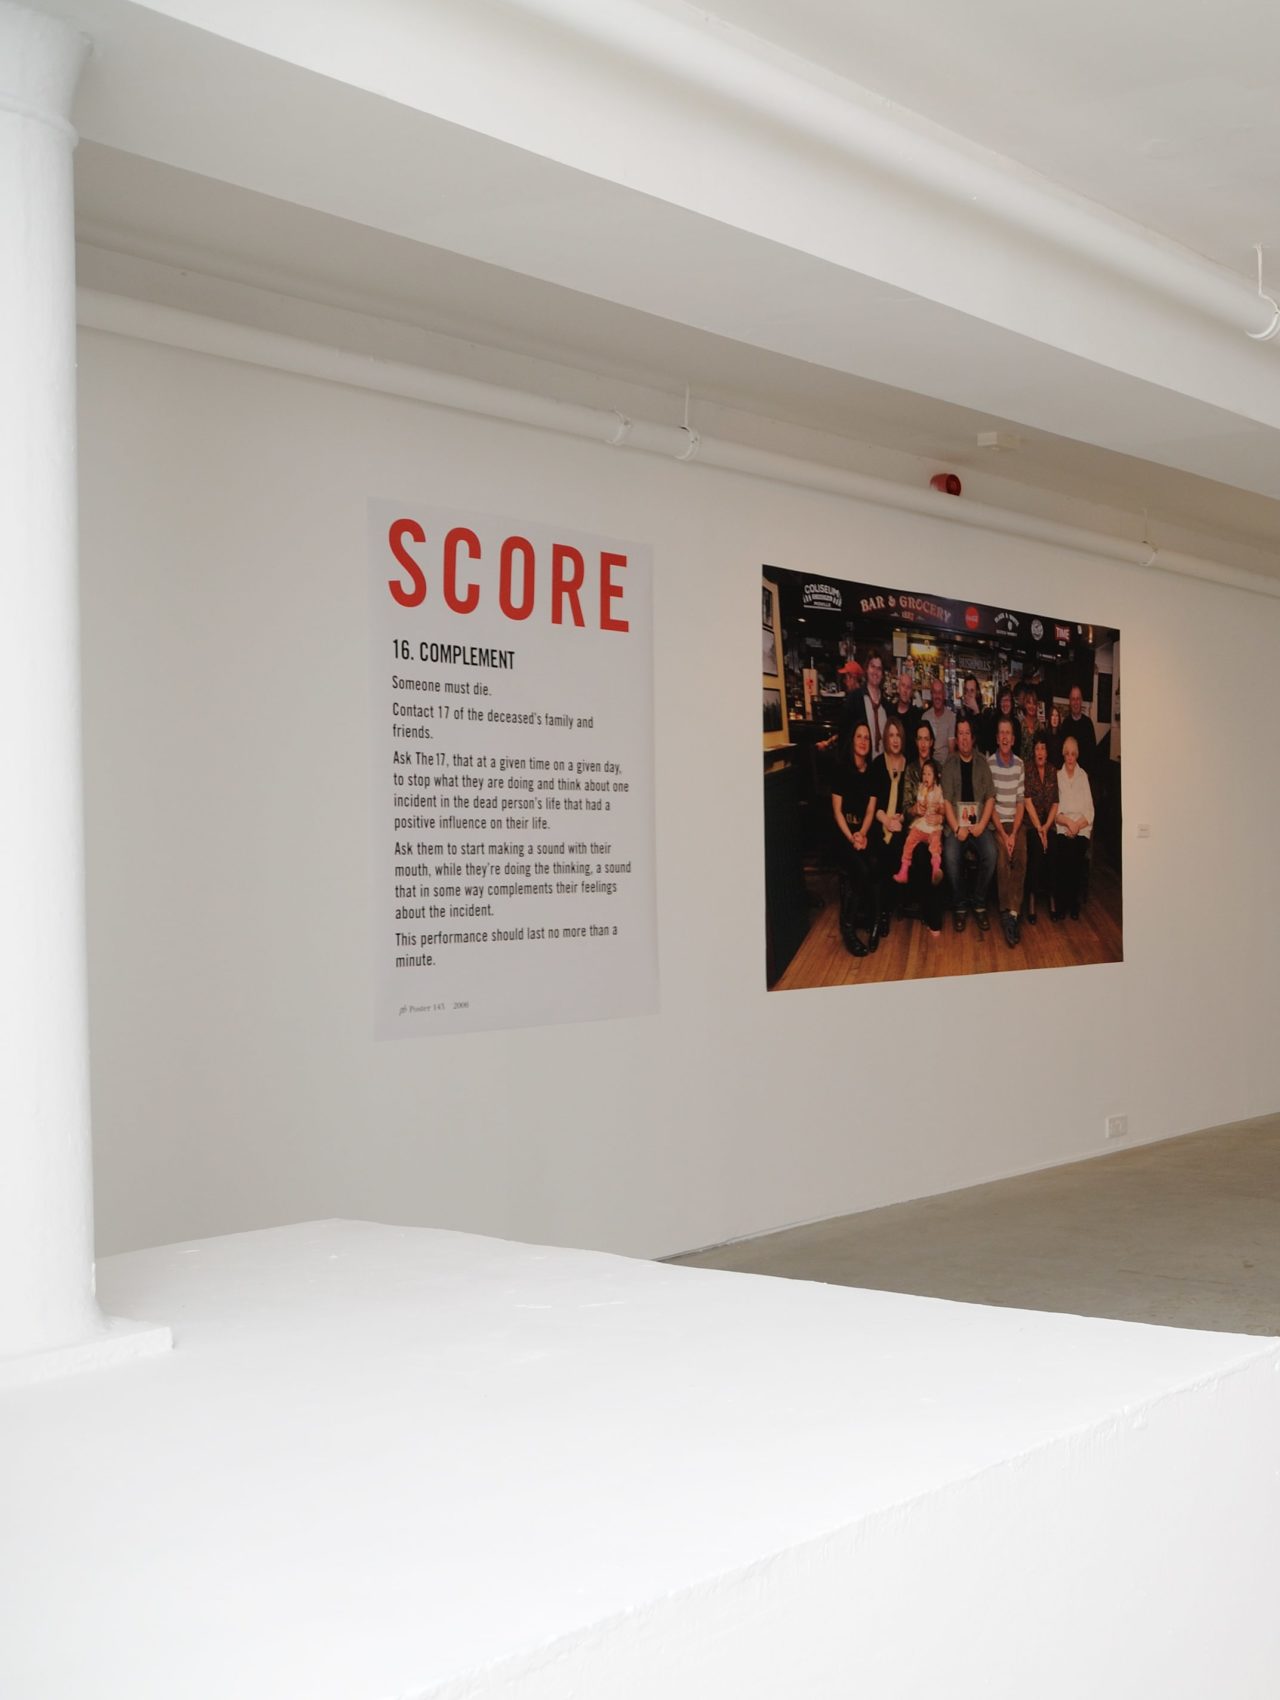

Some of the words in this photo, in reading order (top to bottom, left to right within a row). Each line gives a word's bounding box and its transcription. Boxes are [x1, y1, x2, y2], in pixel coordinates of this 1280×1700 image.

[389, 518, 630, 633] SCORE
[804, 584, 841, 598] COLISEUM
[860, 595, 885, 612] BAR
[888, 595, 896, 608] &
[899, 595, 952, 623] GROCERY
[392, 639, 414, 661] 16.
[419, 641, 515, 670] COMPLEMENT
[392, 675, 441, 692] Someone
[444, 682, 470, 695] must
[473, 682, 491, 696] die.
[392, 702, 434, 718] Contact
[438, 705, 450, 719] 17
[453, 707, 464, 720] of
[467, 708, 484, 722] the
[487, 709, 542, 726] deceased's
[545, 713, 574, 730] family
[577, 716, 593, 728] and
[392, 723, 433, 739] friends.
[393, 750, 412, 765] Ask
[452, 753, 473, 767] that
[477, 755, 487, 768] at
[490, 758, 496, 768] a
[499, 756, 526, 771] given
[529, 757, 550, 770] time
[553, 761, 565, 771] on
[568, 761, 574, 771] a
[576, 759, 601, 774] given
[604, 761, 621, 775] day,
[393, 773, 404, 786] to
[407, 773, 431, 789] stop
[433, 773, 459, 787] what
[461, 774, 484, 791] they
[487, 778, 504, 789] are
[507, 776, 534, 792] doing
[537, 778, 554, 790] and
[557, 778, 581, 790] think
[584, 779, 610, 792] about
[613, 782, 629, 792] one
[394, 793, 437, 808] incident
[440, 794, 450, 808] in
[453, 795, 470, 808] the
[473, 795, 498, 809] dead
[501, 797, 543, 811] person's
[546, 797, 561, 810] life
[564, 798, 583, 810] that
[585, 799, 602, 811] had
[605, 801, 610, 811] a
[394, 815, 436, 831] positive
[439, 815, 487, 829] influence
[490, 819, 502, 829] on
[506, 816, 529, 829] their
[532, 816, 550, 830] life.
[394, 841, 413, 856] Ask
[417, 842, 444, 855] them
[447, 842, 457, 855] to
[460, 842, 485, 855] start
[488, 842, 525, 858] making
[527, 844, 534, 855] a
[537, 842, 565, 855] sound
[568, 842, 587, 854] with
[590, 842, 612, 854] their
[395, 863, 431, 877] mouth,
[435, 862, 462, 876] while
[465, 862, 501, 878] they're
[504, 862, 531, 877] doing
[534, 862, 550, 875] the
[553, 862, 593, 876] thinking,
[596, 864, 602, 874] a
[604, 861, 631, 874] sound
[395, 884, 416, 898] that
[420, 884, 430, 897] in
[433, 886, 461, 897] some
[464, 886, 484, 899] way
[487, 882, 553, 898] complements
[556, 881, 578, 894] their
[581, 880, 617, 895] feelings
[395, 905, 426, 920] about
[429, 905, 446, 918] the
[449, 904, 494, 917] incident.
[395, 932, 417, 946] This
[420, 931, 488, 948] performance
[491, 928, 524, 942] should
[527, 927, 545, 940] last
[548, 928, 559, 938] no
[563, 927, 586, 938] more
[589, 924, 609, 936] than
[612, 926, 618, 935] a
[396, 953, 436, 968] minute.
